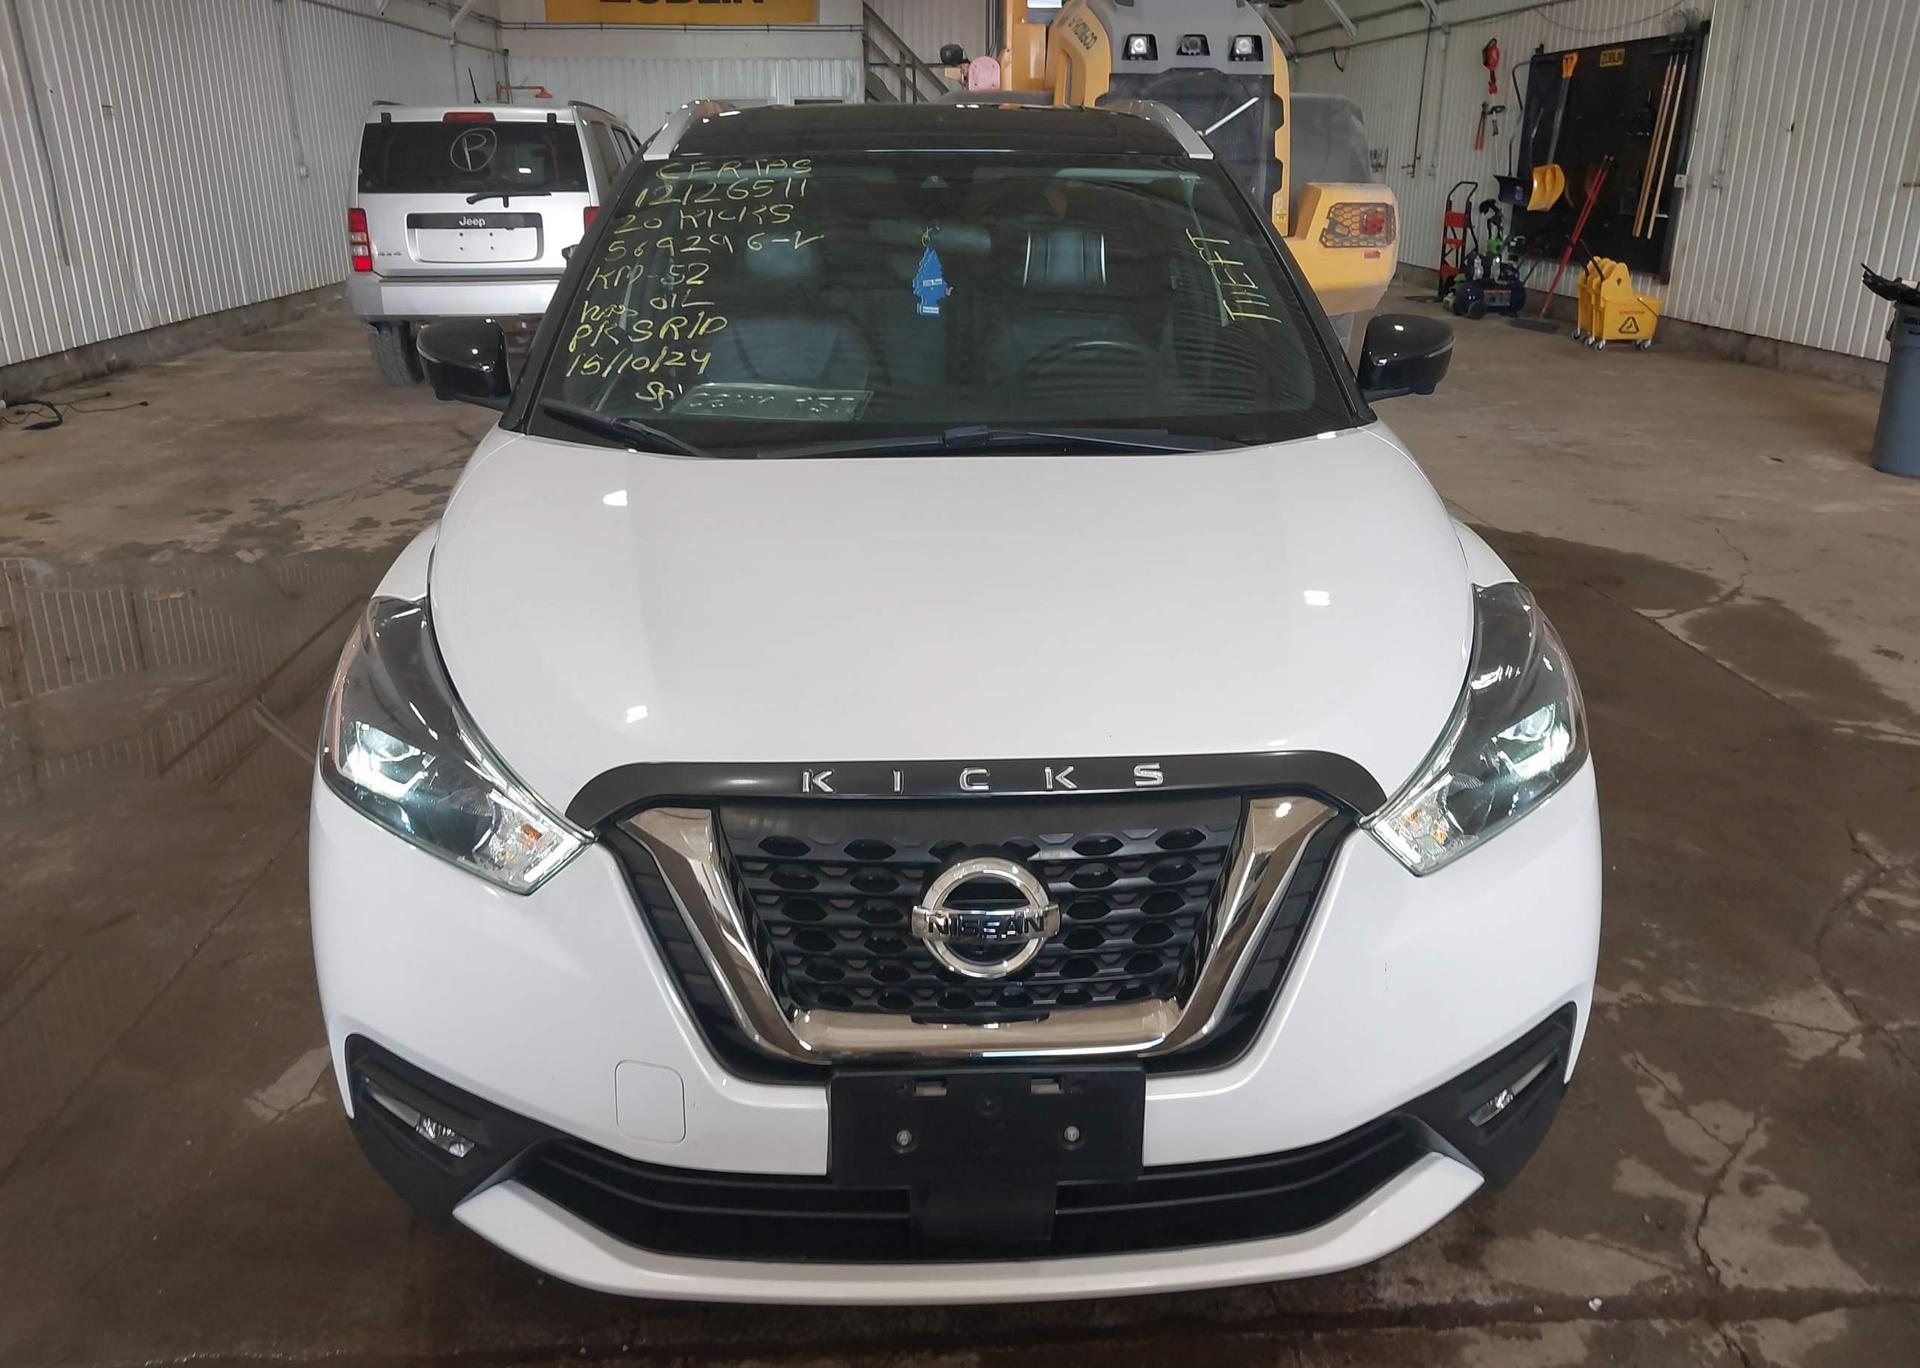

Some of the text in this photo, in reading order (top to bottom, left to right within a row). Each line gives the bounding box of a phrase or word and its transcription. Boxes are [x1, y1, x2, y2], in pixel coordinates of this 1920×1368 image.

[458, 215, 487, 228] Jeep
[613, 214, 663, 235] 20
[802, 762, 1165, 794] KICKS
